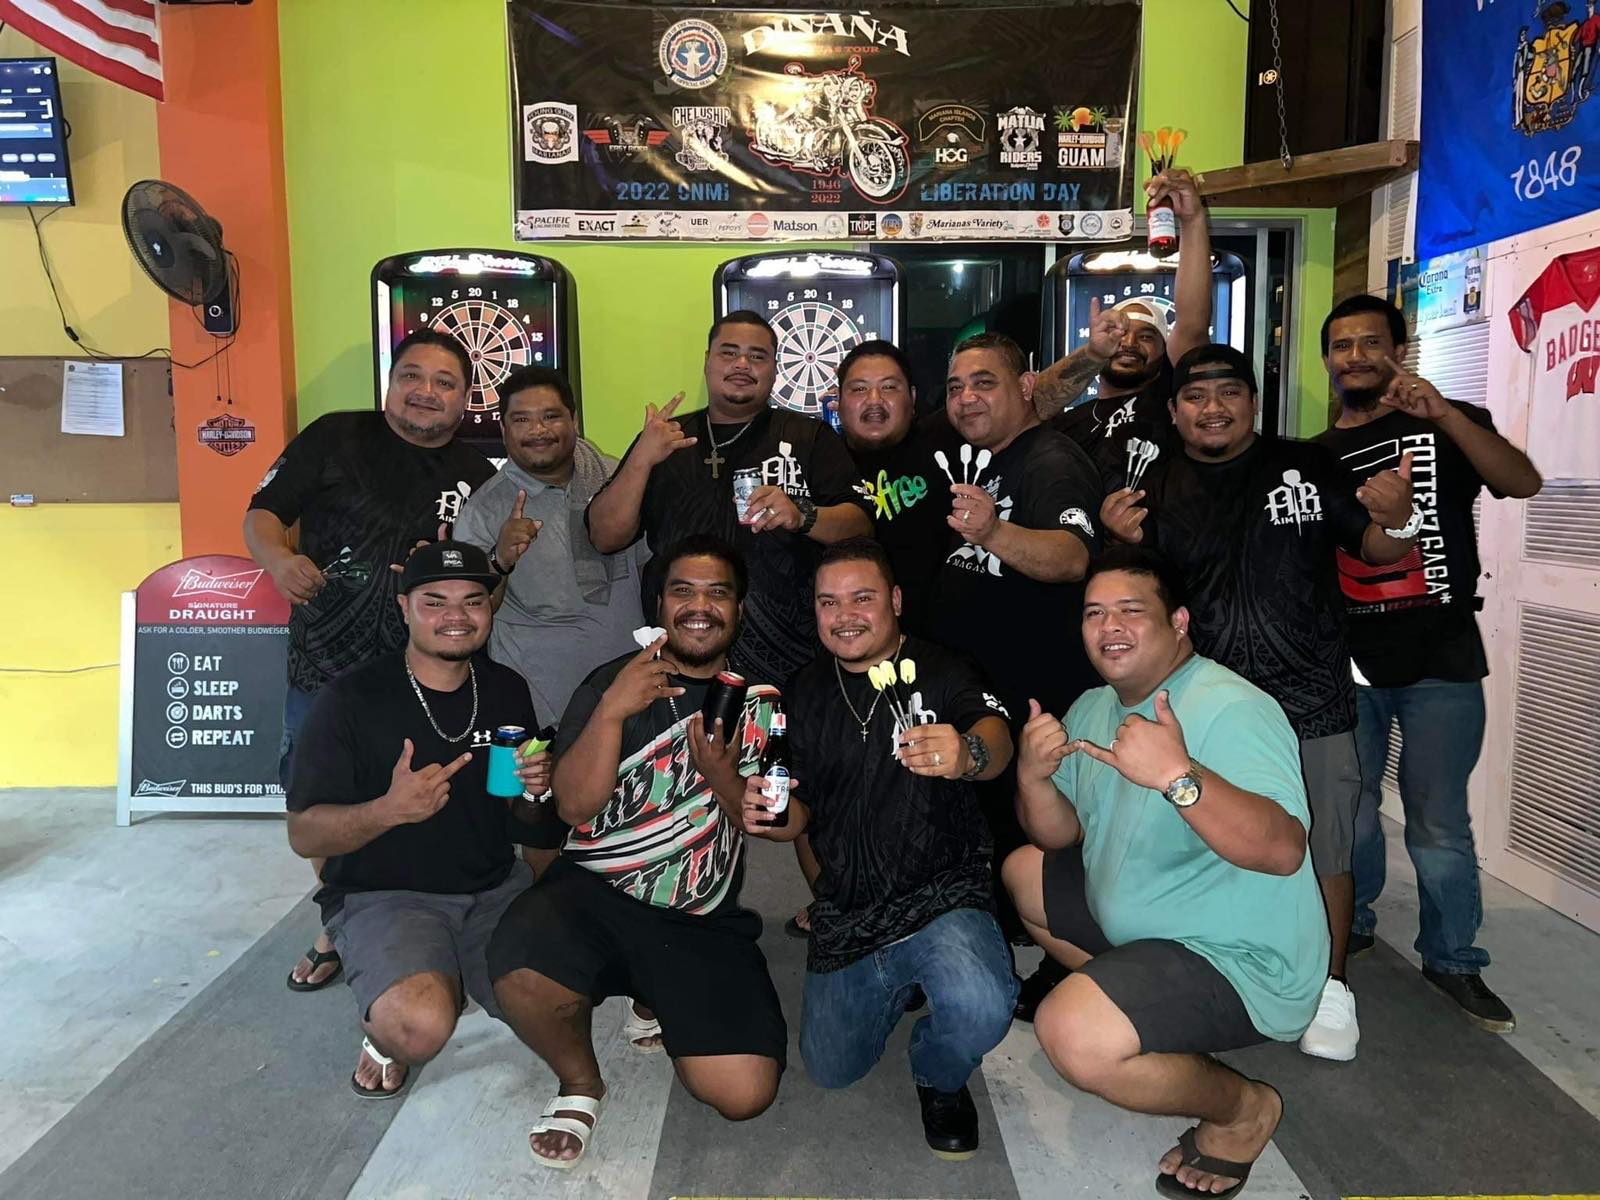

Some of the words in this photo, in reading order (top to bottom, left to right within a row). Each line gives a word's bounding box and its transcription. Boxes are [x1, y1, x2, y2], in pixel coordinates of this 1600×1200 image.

[845, 46, 880, 54] TOUR
[935, 147, 968, 163] HOG
[1000, 151, 1042, 163] RIDERS
[1058, 148, 1105, 166] GUAM
[1510, 146, 1582, 201] 1848
[615, 182, 670, 201] 2022
[920, 182, 1036, 201] LIBERATION
[1043, 182, 1081, 201] DAY
[534, 216, 572, 224] PACIFIC
[690, 218, 709, 226] UER
[926, 219, 971, 229] Marianas
[972, 217, 1005, 229] Variety
[578, 220, 616, 231] EXACT
[773, 220, 818, 231] Matson
[1418, 269, 1449, 288] Corona
[468, 288, 482, 297] 20
[1123, 286, 1131, 295] 5
[1140, 283, 1155, 293] 20
[1163, 286, 1170, 295] 1
[1426, 286, 1443, 295] Extra
[451, 290, 459, 299] 5
[492, 291, 498, 299] 1
[787, 292, 795, 301] 5
[803, 289, 818, 298] 20
[827, 292, 833, 300] 1
[432, 298, 443, 307] 12
[507, 299, 519, 308] 18
[842, 299, 854, 309] 18
[1103, 295, 1116, 304] 12
[767, 300, 779, 310] 12
[420, 313, 428, 322] 9
[522, 315, 531, 324] 4
[856, 314, 864, 324] 4
[534, 352, 543, 361] 6
[474, 414, 482, 424] 3
[788, 487, 811, 498] RITE
[876, 469, 928, 521] free
[438, 514, 456, 523] AIM
[1273, 516, 1294, 526] AIM
[1301, 513, 1324, 522] RITE
[953, 558, 986, 574] MAGAS
[183, 573, 253, 591] Budweiser
[188, 601, 238, 609] SIGNATURE
[169, 609, 256, 620] DRAUGHT
[138, 626, 152, 634] ASK
[153, 626, 167, 634] FOR
[168, 626, 175, 634] A
[207, 626, 246, 634] SMOOTHER
[194, 656, 222, 671] EAT
[193, 681, 239, 696] SLEEP
[192, 705, 243, 720] DARTS
[191, 730, 254, 746] REPEAT
[140, 781, 181, 793] Budweiser
[190, 783, 212, 794] THIS
[214, 783, 243, 794] BUD'S
[244, 783, 262, 794] FOR
